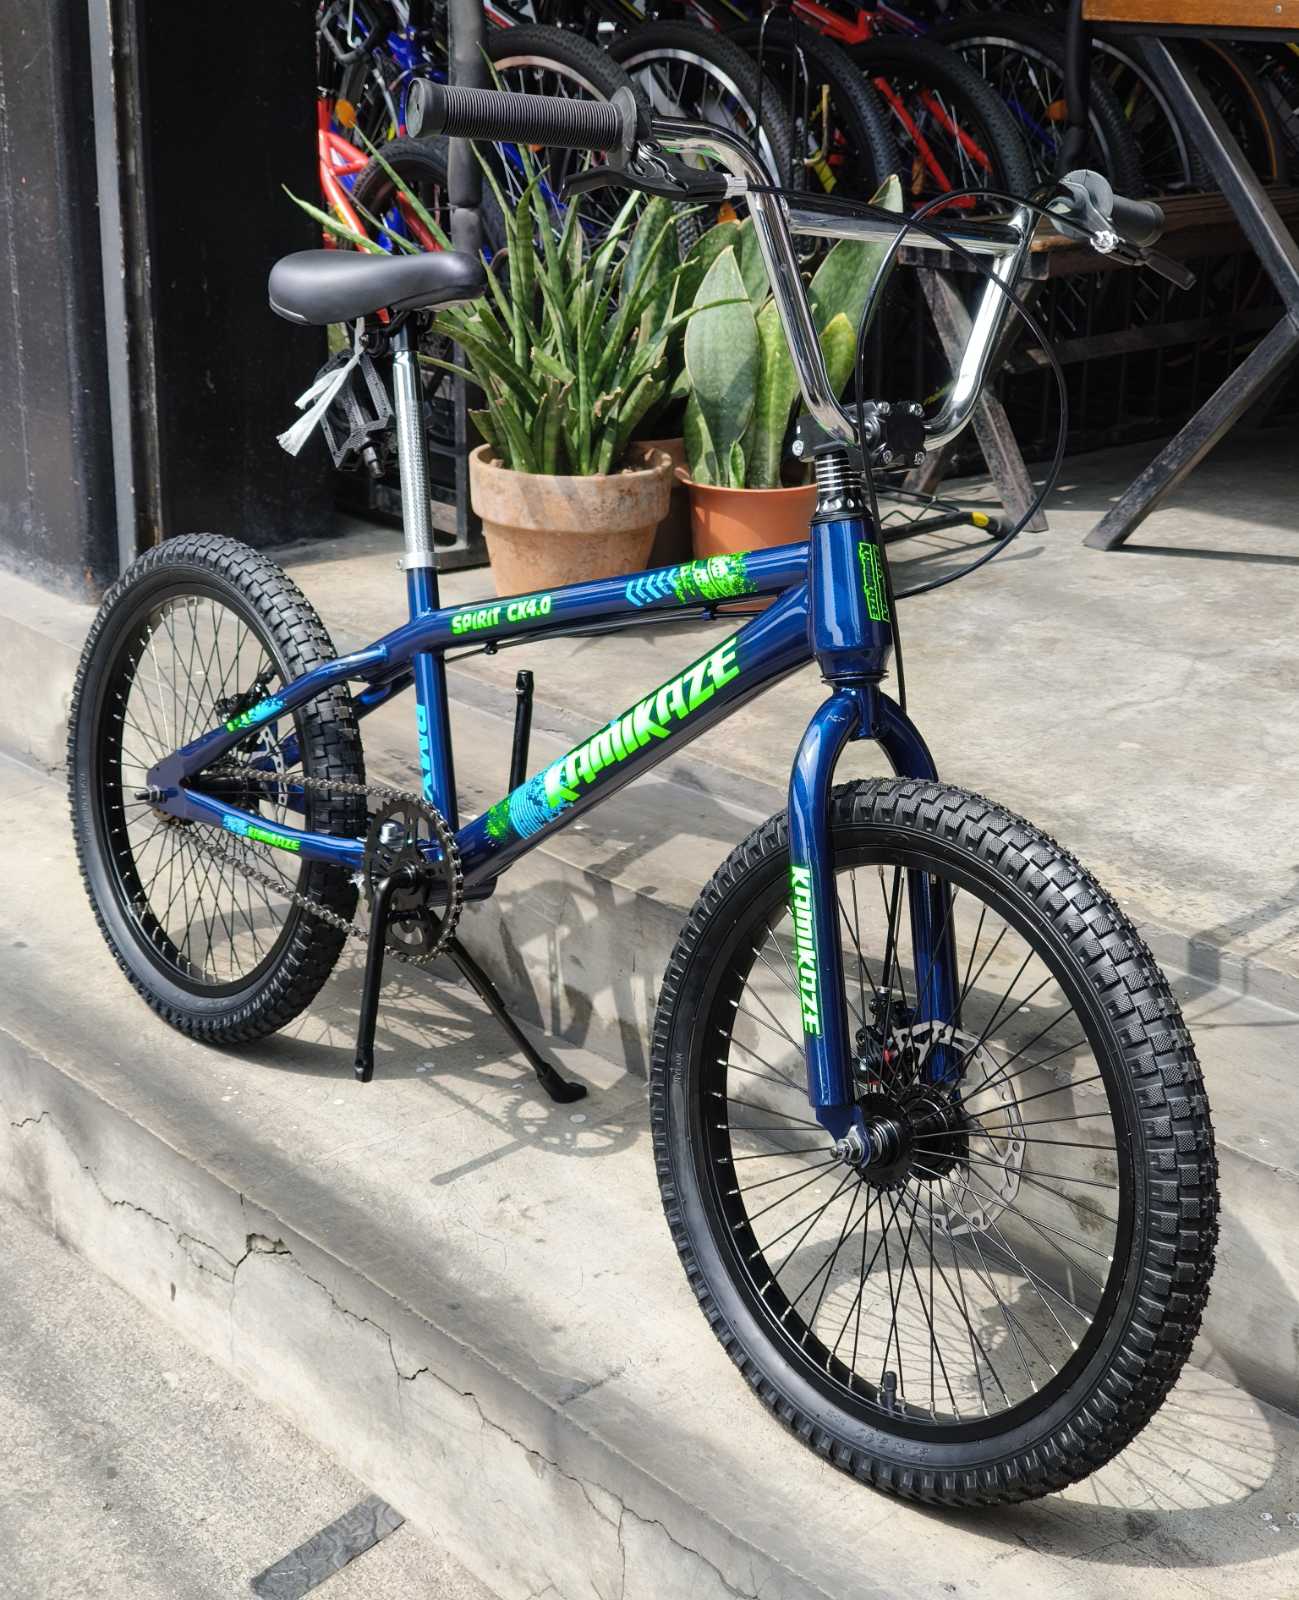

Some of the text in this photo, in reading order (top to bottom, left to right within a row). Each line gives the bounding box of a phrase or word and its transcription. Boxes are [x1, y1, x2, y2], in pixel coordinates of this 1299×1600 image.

[451, 606, 501, 635] SPIRIT
[544, 637, 740, 809] KAMIKAZE
[790, 864, 821, 1036] KAMIKAZE
